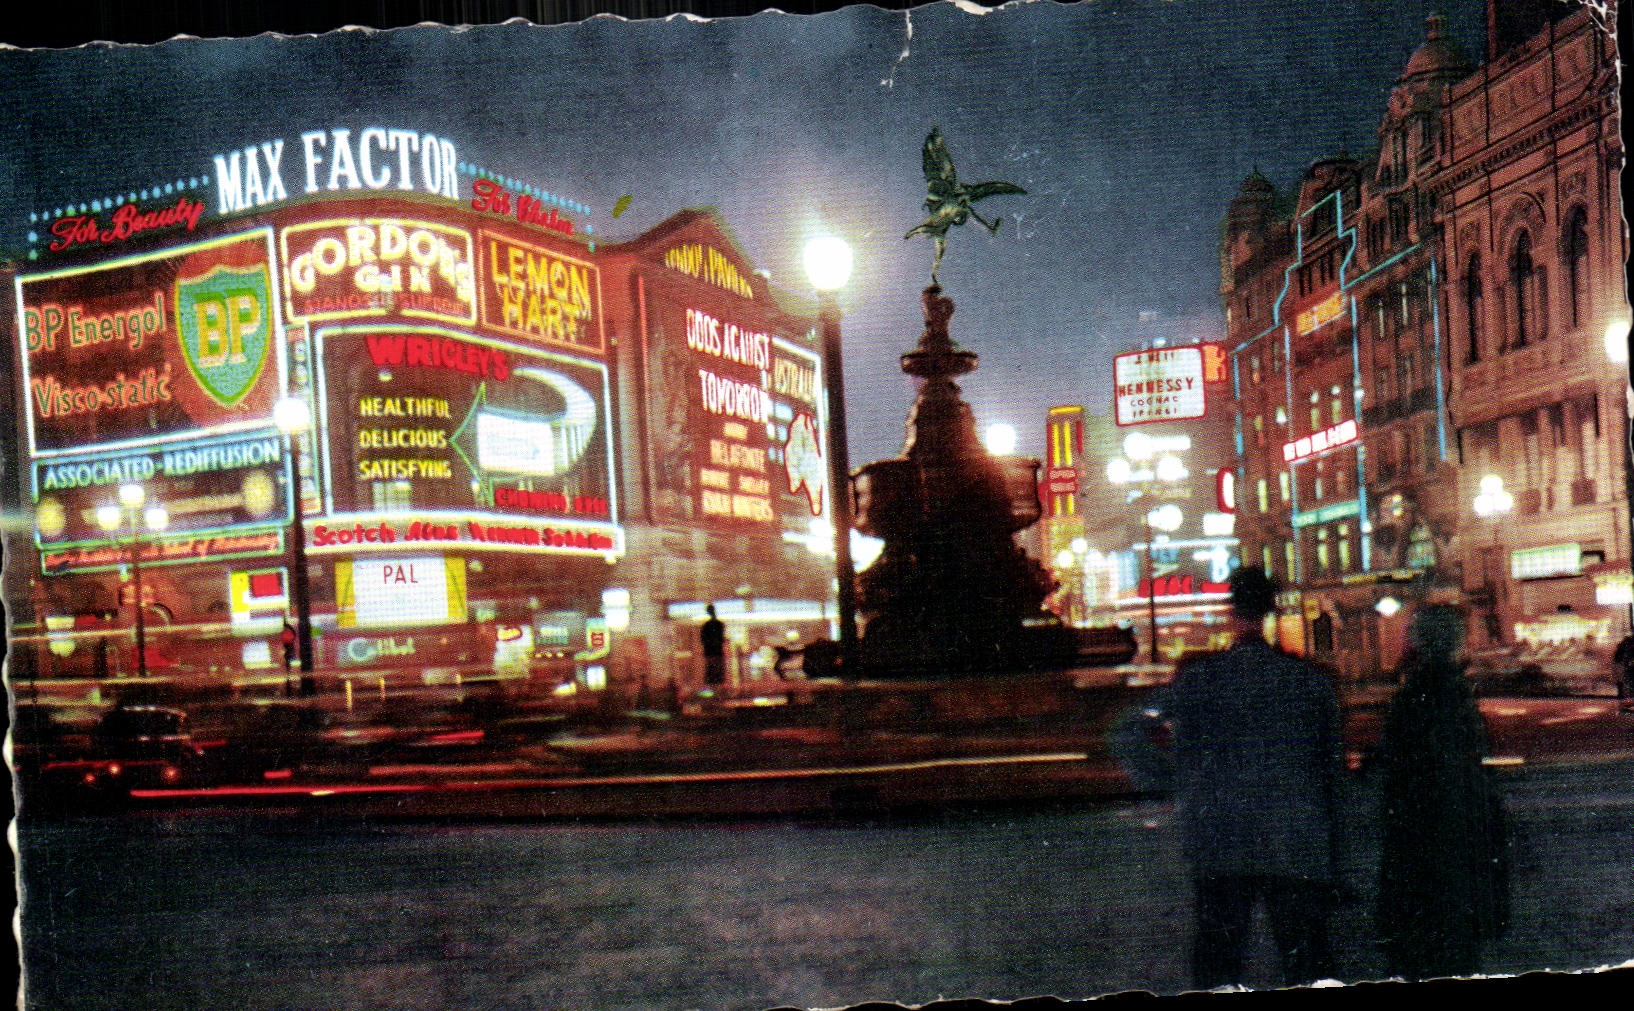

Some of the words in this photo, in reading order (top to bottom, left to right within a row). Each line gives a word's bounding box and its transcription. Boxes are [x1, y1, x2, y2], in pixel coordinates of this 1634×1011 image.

[214, 138, 288, 214] MAX
[301, 126, 460, 201] FACTOR
[50, 215, 99, 252] For
[101, 197, 205, 244] Beauty
[354, 264, 432, 292] GIN
[490, 240, 592, 321] LEMON
[23, 303, 64, 351] BP
[67, 291, 166, 349] Energol
[502, 285, 582, 344] HART
[194, 290, 260, 368] BP
[686, 308, 721, 357] ODDS
[1118, 376, 1194, 397] HENNESSY
[358, 397, 451, 419] HEALTHFUL
[1130, 395, 1179, 407] COGNAC
[358, 429, 448, 448] DELICIOUS
[358, 459, 452, 479] SATISFYING
[312, 523, 396, 547] Scotch
[383, 564, 418, 585] PAL
